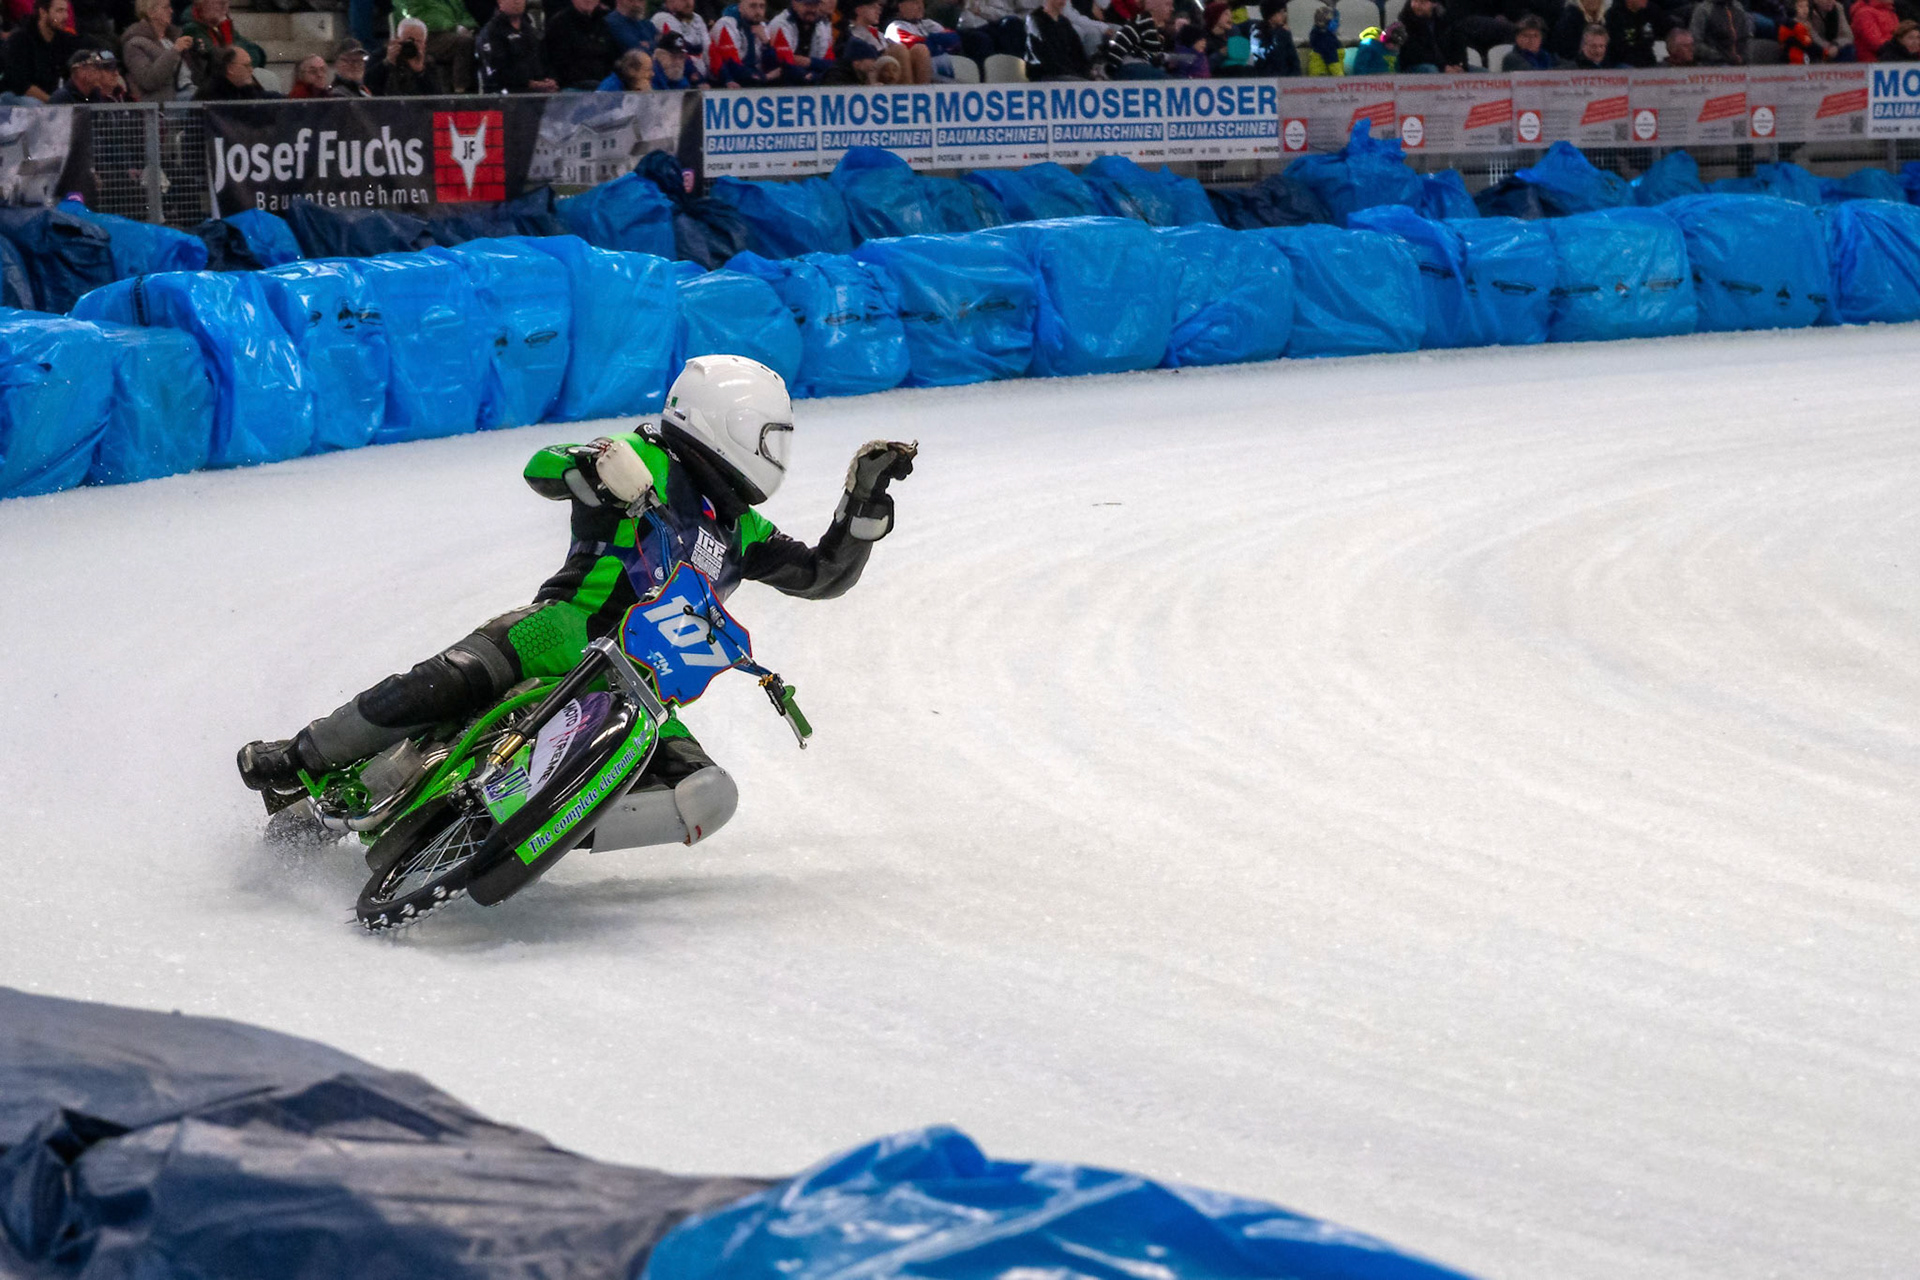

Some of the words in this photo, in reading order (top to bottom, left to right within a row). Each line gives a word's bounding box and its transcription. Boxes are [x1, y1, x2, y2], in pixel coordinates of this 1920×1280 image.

[1873, 69, 1920, 98] MO
[706, 96, 817, 130] MOSER
[821, 93, 932, 126] MOSER
[936, 89, 1047, 122] MOSER
[1051, 87, 1163, 119] MOSER
[1166, 85, 1278, 117] MOSER
[707, 132, 816, 152] BAUMASCHINEN
[822, 130, 931, 148] BAUMASCHINEN
[937, 127, 1047, 145] BAUMASCHINEN
[1053, 124, 1162, 141] BAUMASCHINEN
[1168, 121, 1277, 139] BAUMASCHINEN
[214, 128, 312, 194] Josef
[318, 125, 424, 178] Fuchs
[463, 140, 475, 160] JF
[255, 184, 429, 211] Baunternehmen
[695, 526, 727, 563] ICE
[642, 595, 731, 667] 107
[651, 651, 673, 676] FIM
[564, 701, 578, 728] MOTO
[527, 830, 552, 855] The
[554, 787, 599, 835] complete
[599, 748, 636, 791] electronic
